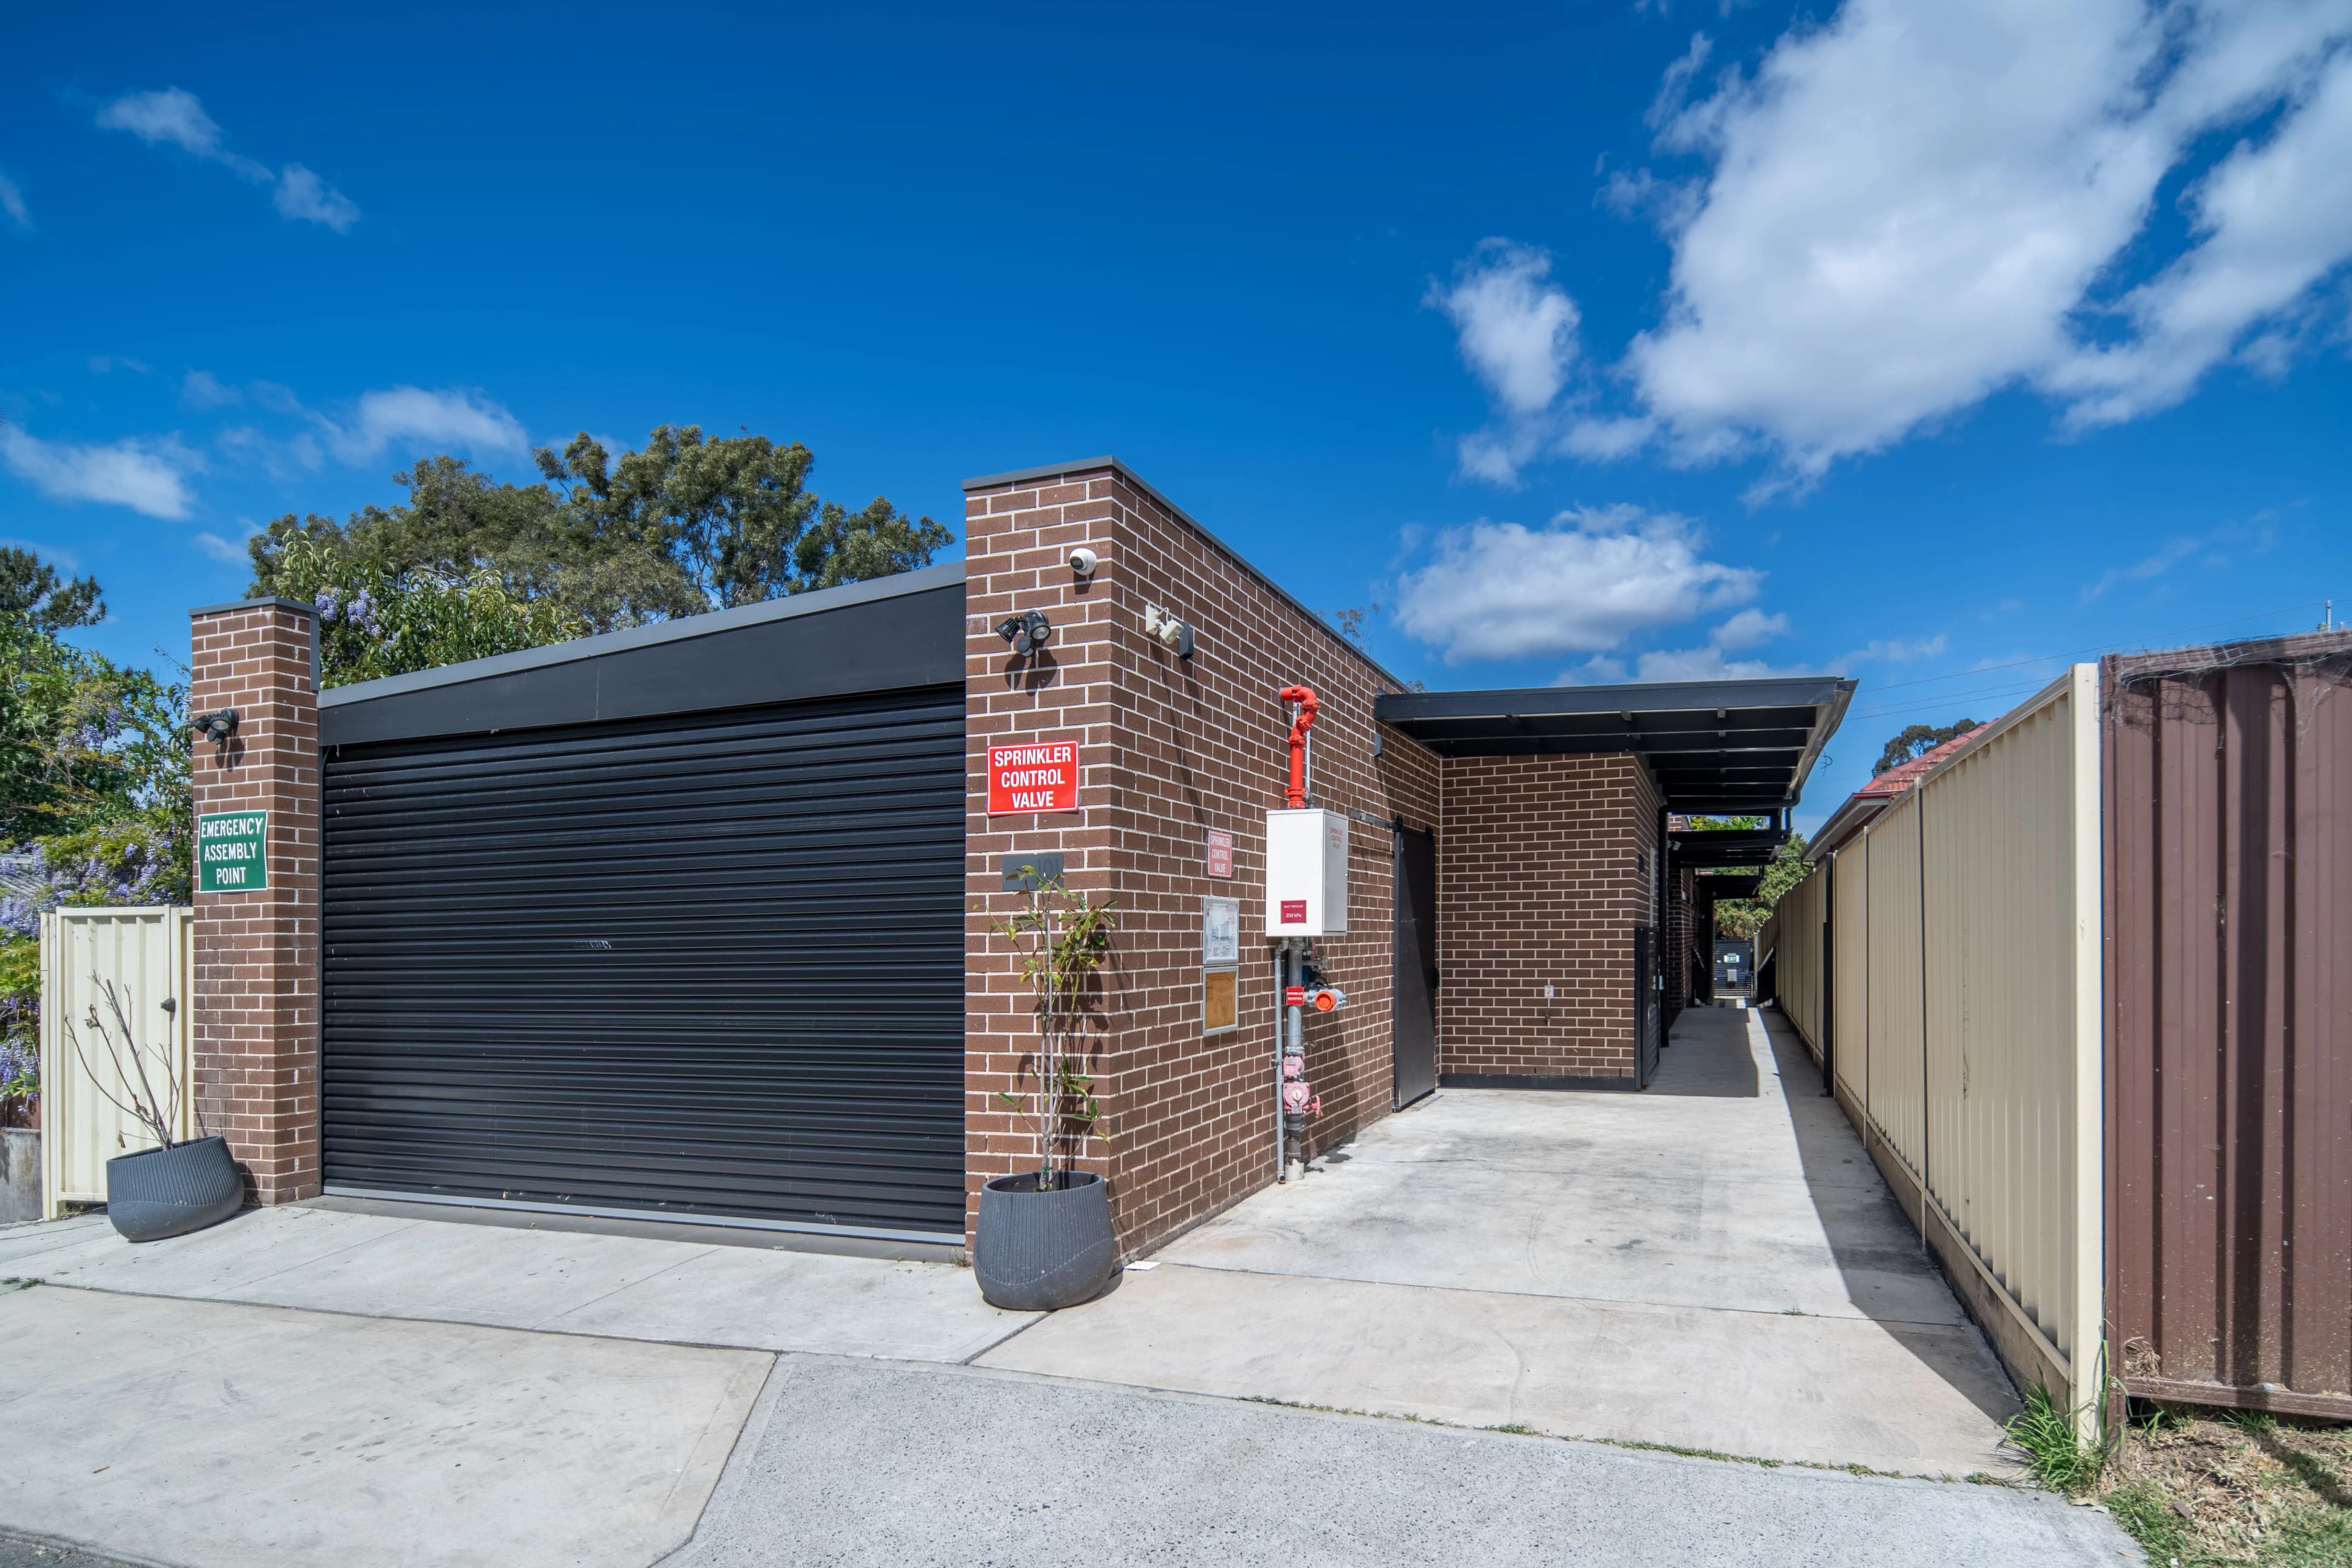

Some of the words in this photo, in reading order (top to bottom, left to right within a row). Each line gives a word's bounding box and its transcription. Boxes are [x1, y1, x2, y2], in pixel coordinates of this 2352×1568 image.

[994, 746, 1071, 767] SPRINKLER
[1001, 769, 1065, 788] CONTROL
[1012, 791, 1054, 809] VALVE
[201, 817, 263, 838] EMERGENCY
[1210, 835, 1231, 848] SPRINKLER
[205, 842, 257, 861] ASSEMBLY
[1212, 848, 1229, 861] CONTROL
[216, 867, 246, 884] POINT
[1214, 862, 1226, 873] VALVE
